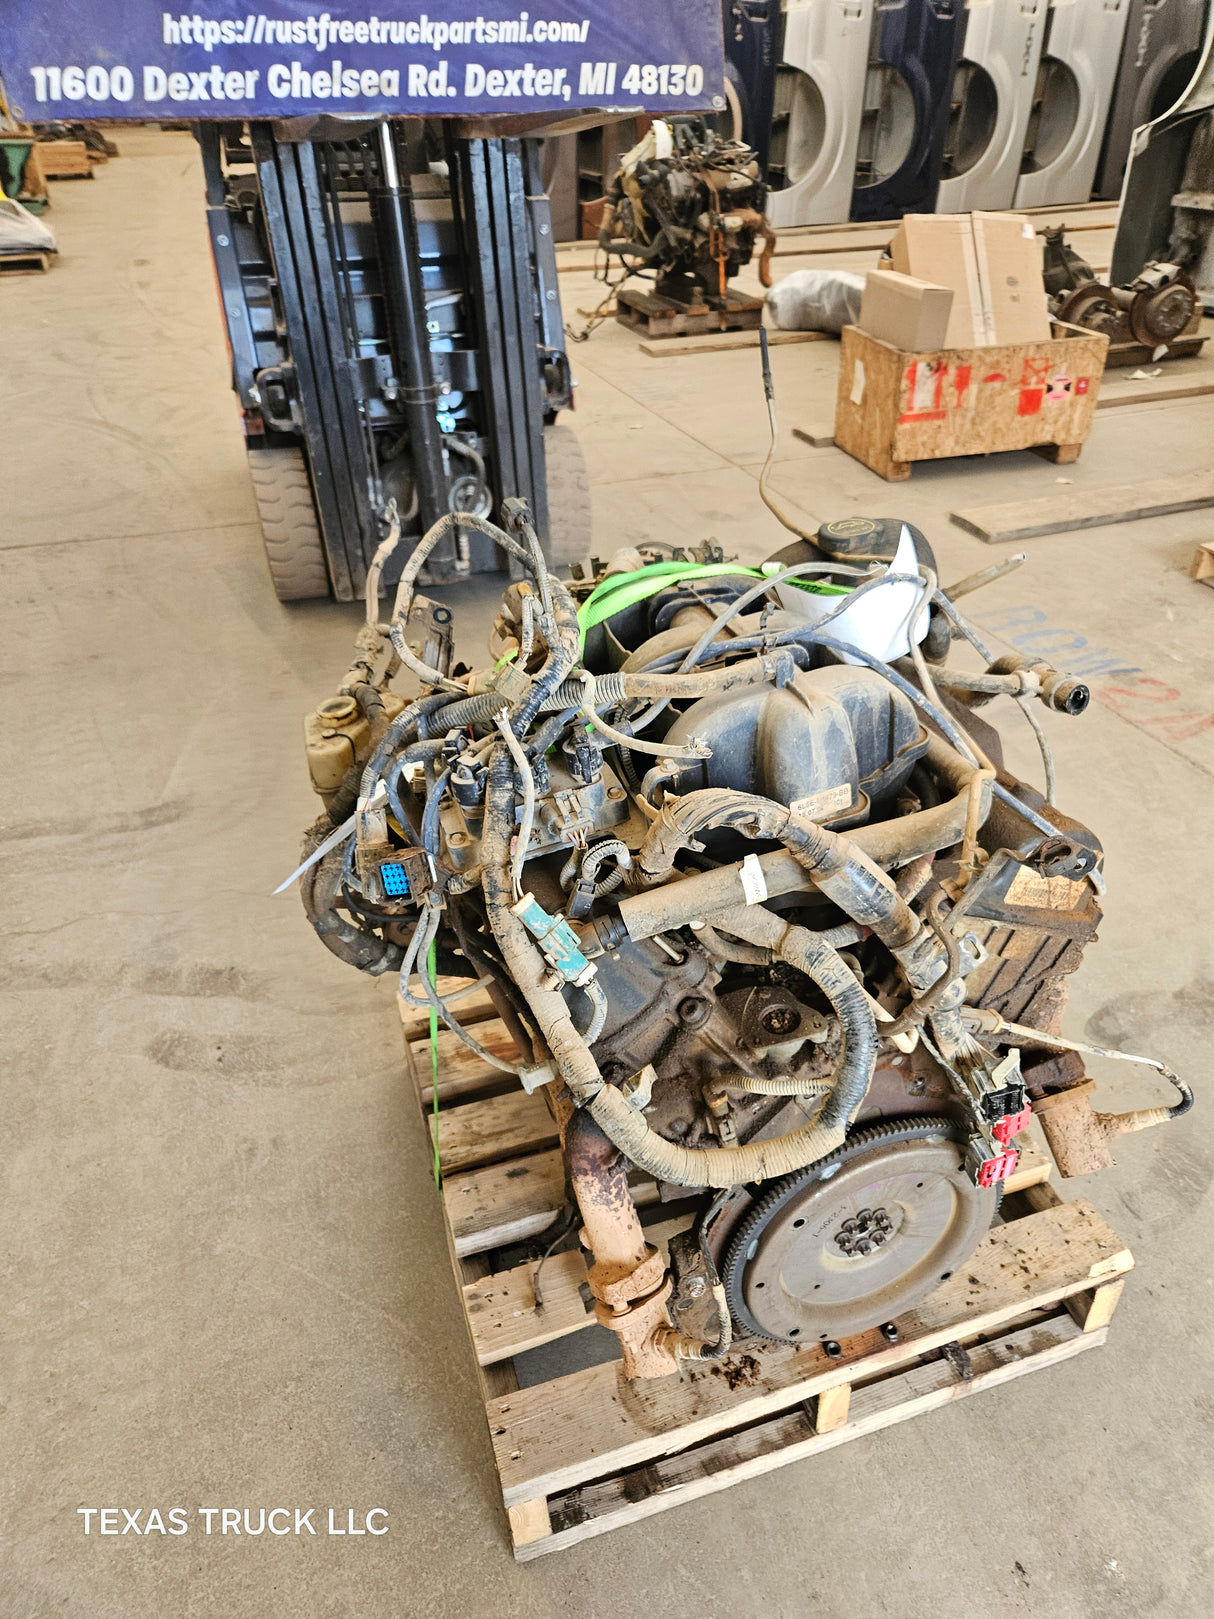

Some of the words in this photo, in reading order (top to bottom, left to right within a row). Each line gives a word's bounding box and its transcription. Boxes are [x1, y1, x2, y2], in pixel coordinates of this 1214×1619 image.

[163, 12, 590, 51] https://rustfreetruckpartsmi.com/
[30, 65, 134, 102] 11600
[143, 64, 259, 101] Dexter
[267, 60, 400, 98] Chelsea
[407, 60, 457, 97] Rd.
[464, 62, 571, 101] Dexter,
[579, 62, 617, 95] MI
[621, 64, 704, 97] 48130
